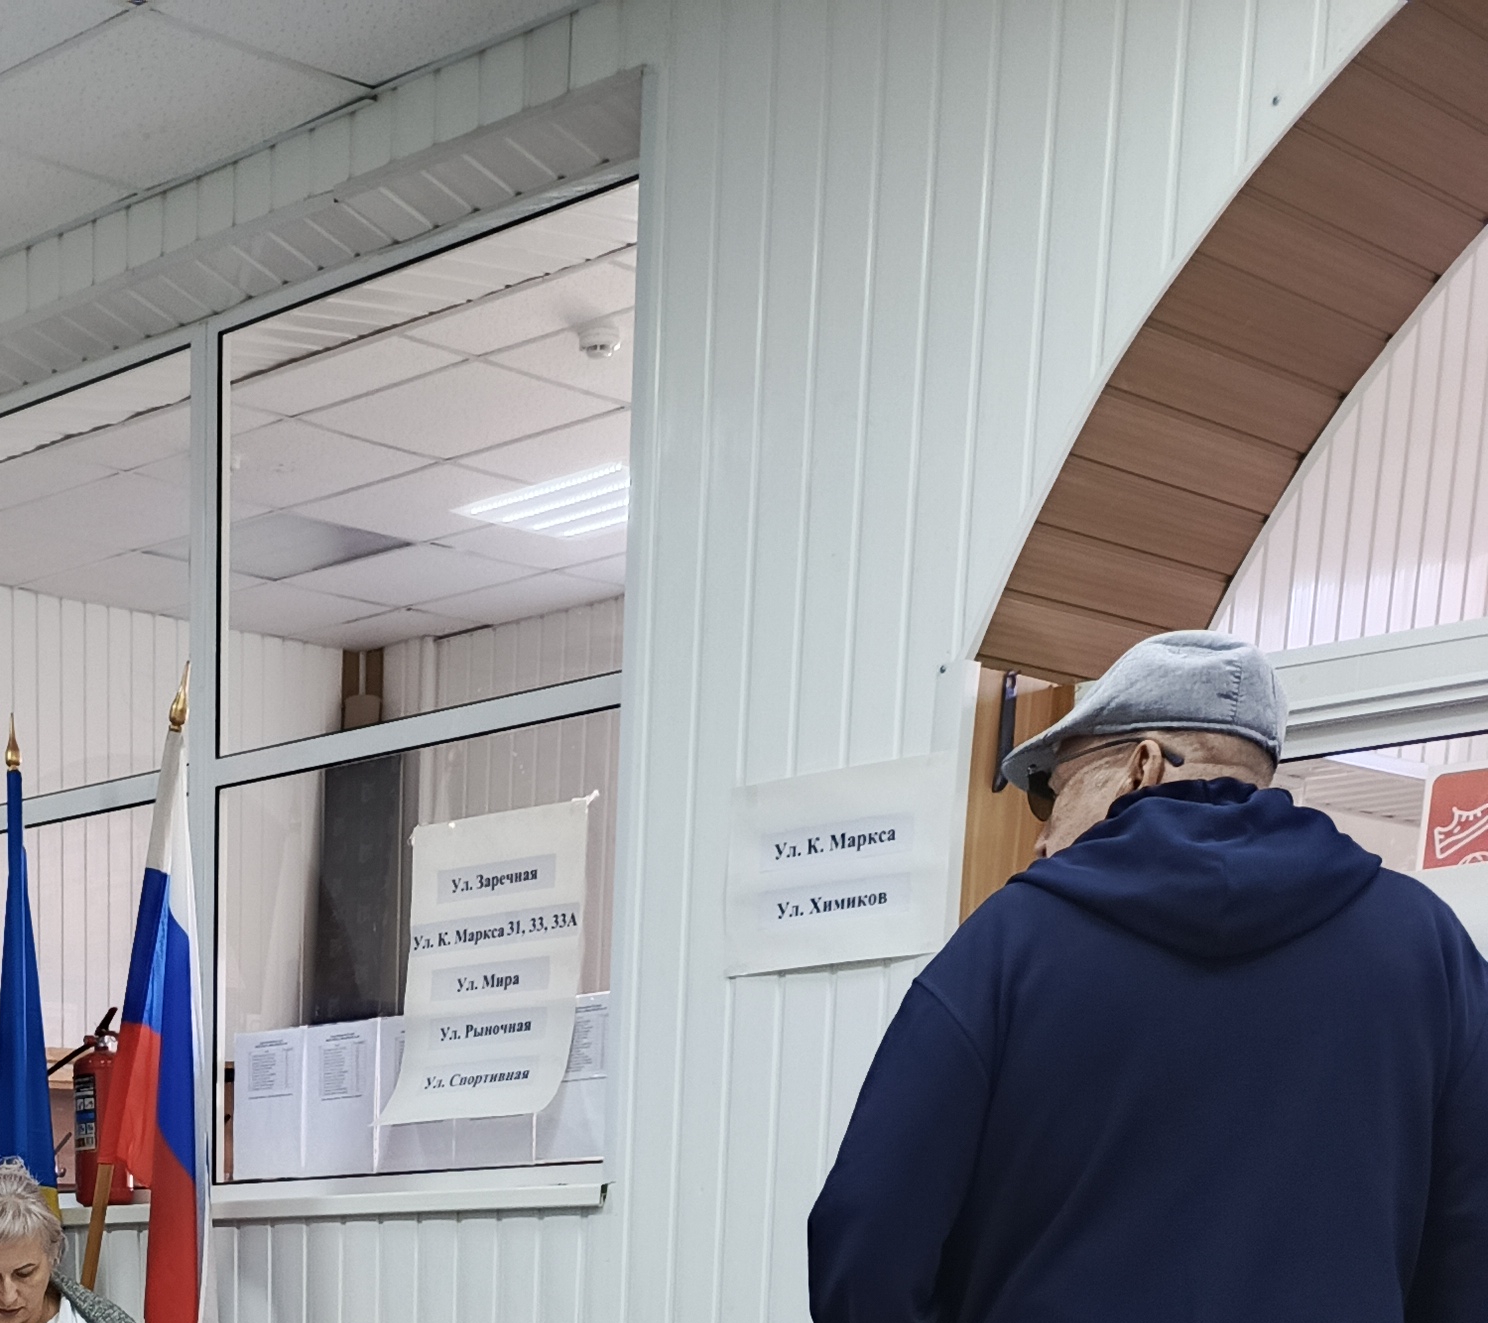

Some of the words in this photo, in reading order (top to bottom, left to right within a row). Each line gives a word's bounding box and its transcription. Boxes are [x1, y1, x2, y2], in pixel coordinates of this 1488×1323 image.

[774, 841, 802, 860] Ул.
[806, 836, 824, 855] К.
[829, 828, 896, 852] Маркса
[451, 877, 473, 893] Ул.
[476, 868, 538, 891] Заречная
[776, 901, 804, 919] Ул.
[809, 891, 888, 915] Химиков
[413, 934, 434, 950] Ул.
[437, 932, 451, 947] К.
[454, 926, 505, 945] Маркса
[506, 919, 525, 936] 31,
[528, 916, 548, 933] 33,
[552, 912, 578, 929] 33А
[456, 977, 478, 992] Ул.
[481, 973, 520, 990] Мира
[440, 1027, 461, 1042] Ул.
[464, 1020, 532, 1039] Рыночная
[424, 1076, 445, 1089] Ул.
[449, 1069, 530, 1088] Спортивная
